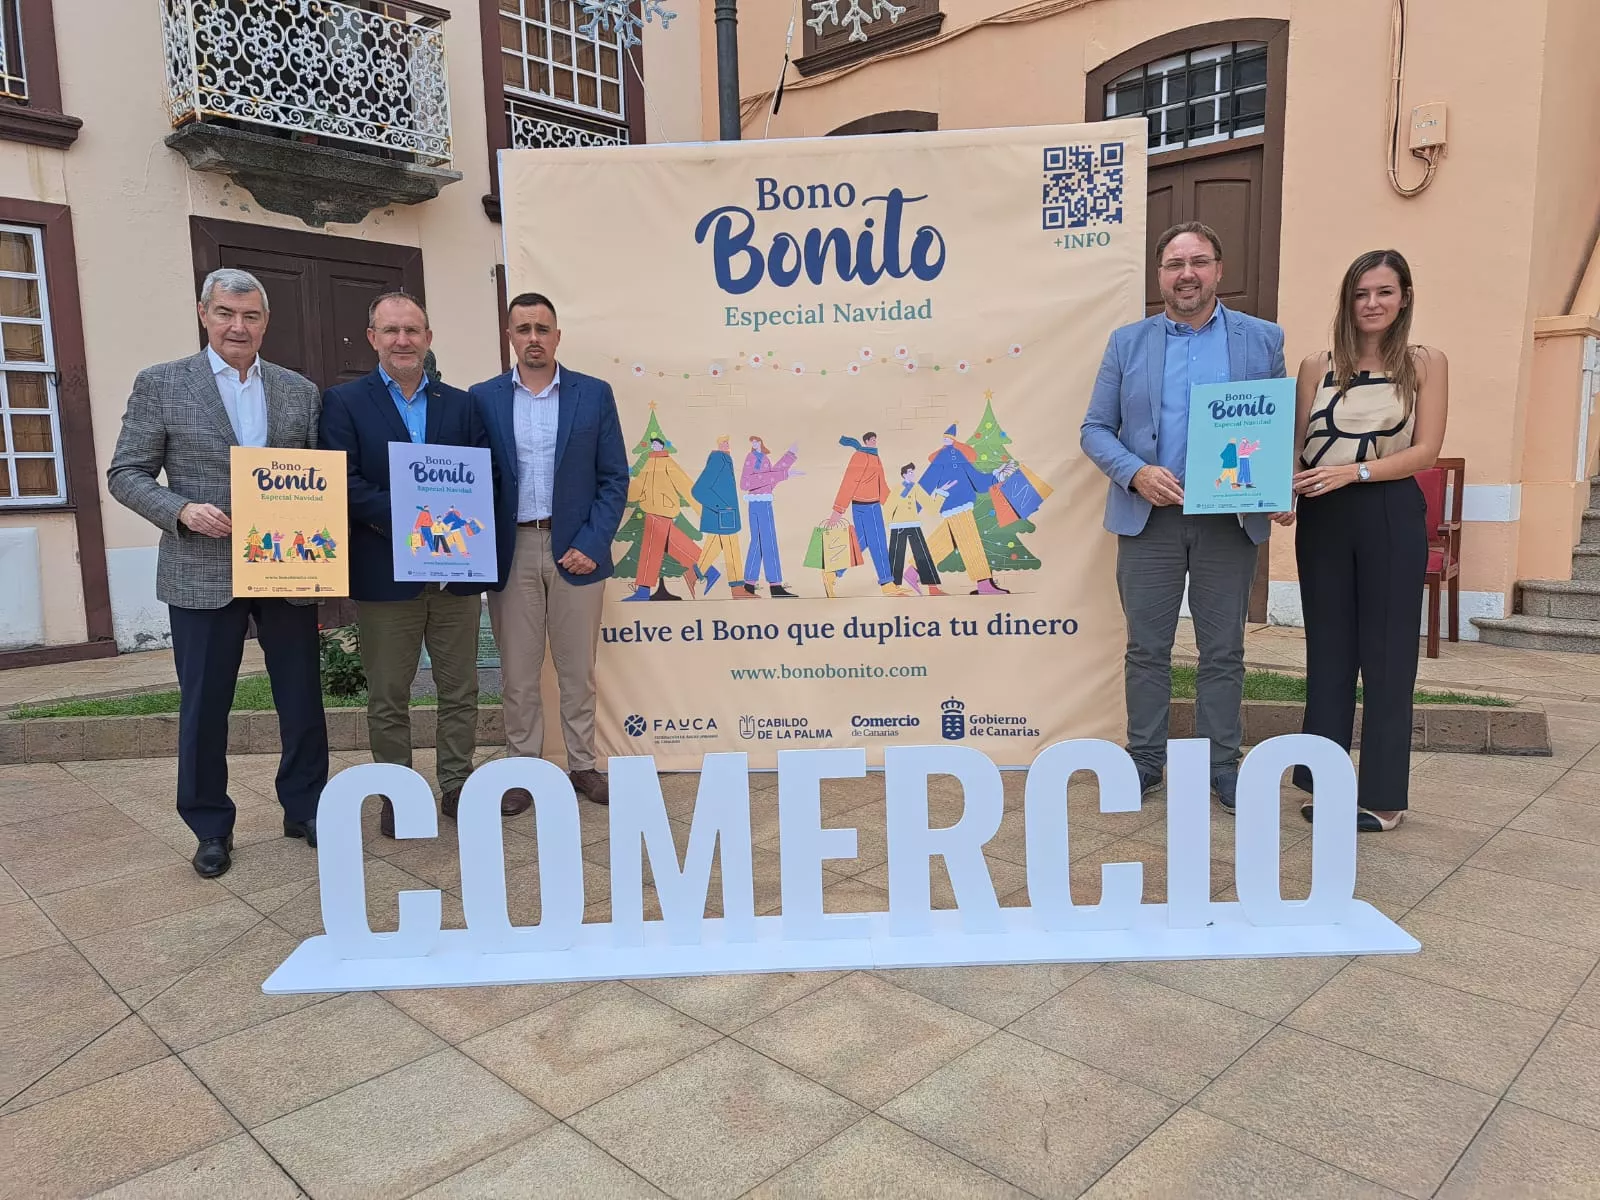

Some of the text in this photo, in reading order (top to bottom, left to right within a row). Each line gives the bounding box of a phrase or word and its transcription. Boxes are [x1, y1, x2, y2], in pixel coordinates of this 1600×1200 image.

[754, 177, 856, 212] Bono
[695, 188, 947, 295] Bonito
[1053, 232, 1111, 250] +INFO
[724, 299, 933, 332] Especial Navidad
[1225, 393, 1252, 401] Bono
[1207, 395, 1276, 420] Bonito
[271, 461, 301, 471] Bono
[425, 456, 452, 465] Bono
[252, 467, 327, 491] Bonito
[409, 461, 475, 484] Bonito
[417, 485, 445, 493] Especial
[260, 493, 292, 502] Especial
[600, 613, 1079, 645] uelve el Bono que duplica tu dinero
[730, 663, 928, 681] www.bonobonito.com
[653, 717, 719, 732] FAUCA
[757, 717, 809, 728] CABILDO
[851, 715, 920, 728] Comercio
[969, 714, 1027, 725] Gobierno
[757, 729, 833, 740] DE LA PALMA
[851, 729, 899, 737] de Canarias
[969, 727, 1040, 737] de Canarias
[317, 733, 1359, 960] COMERCIO
